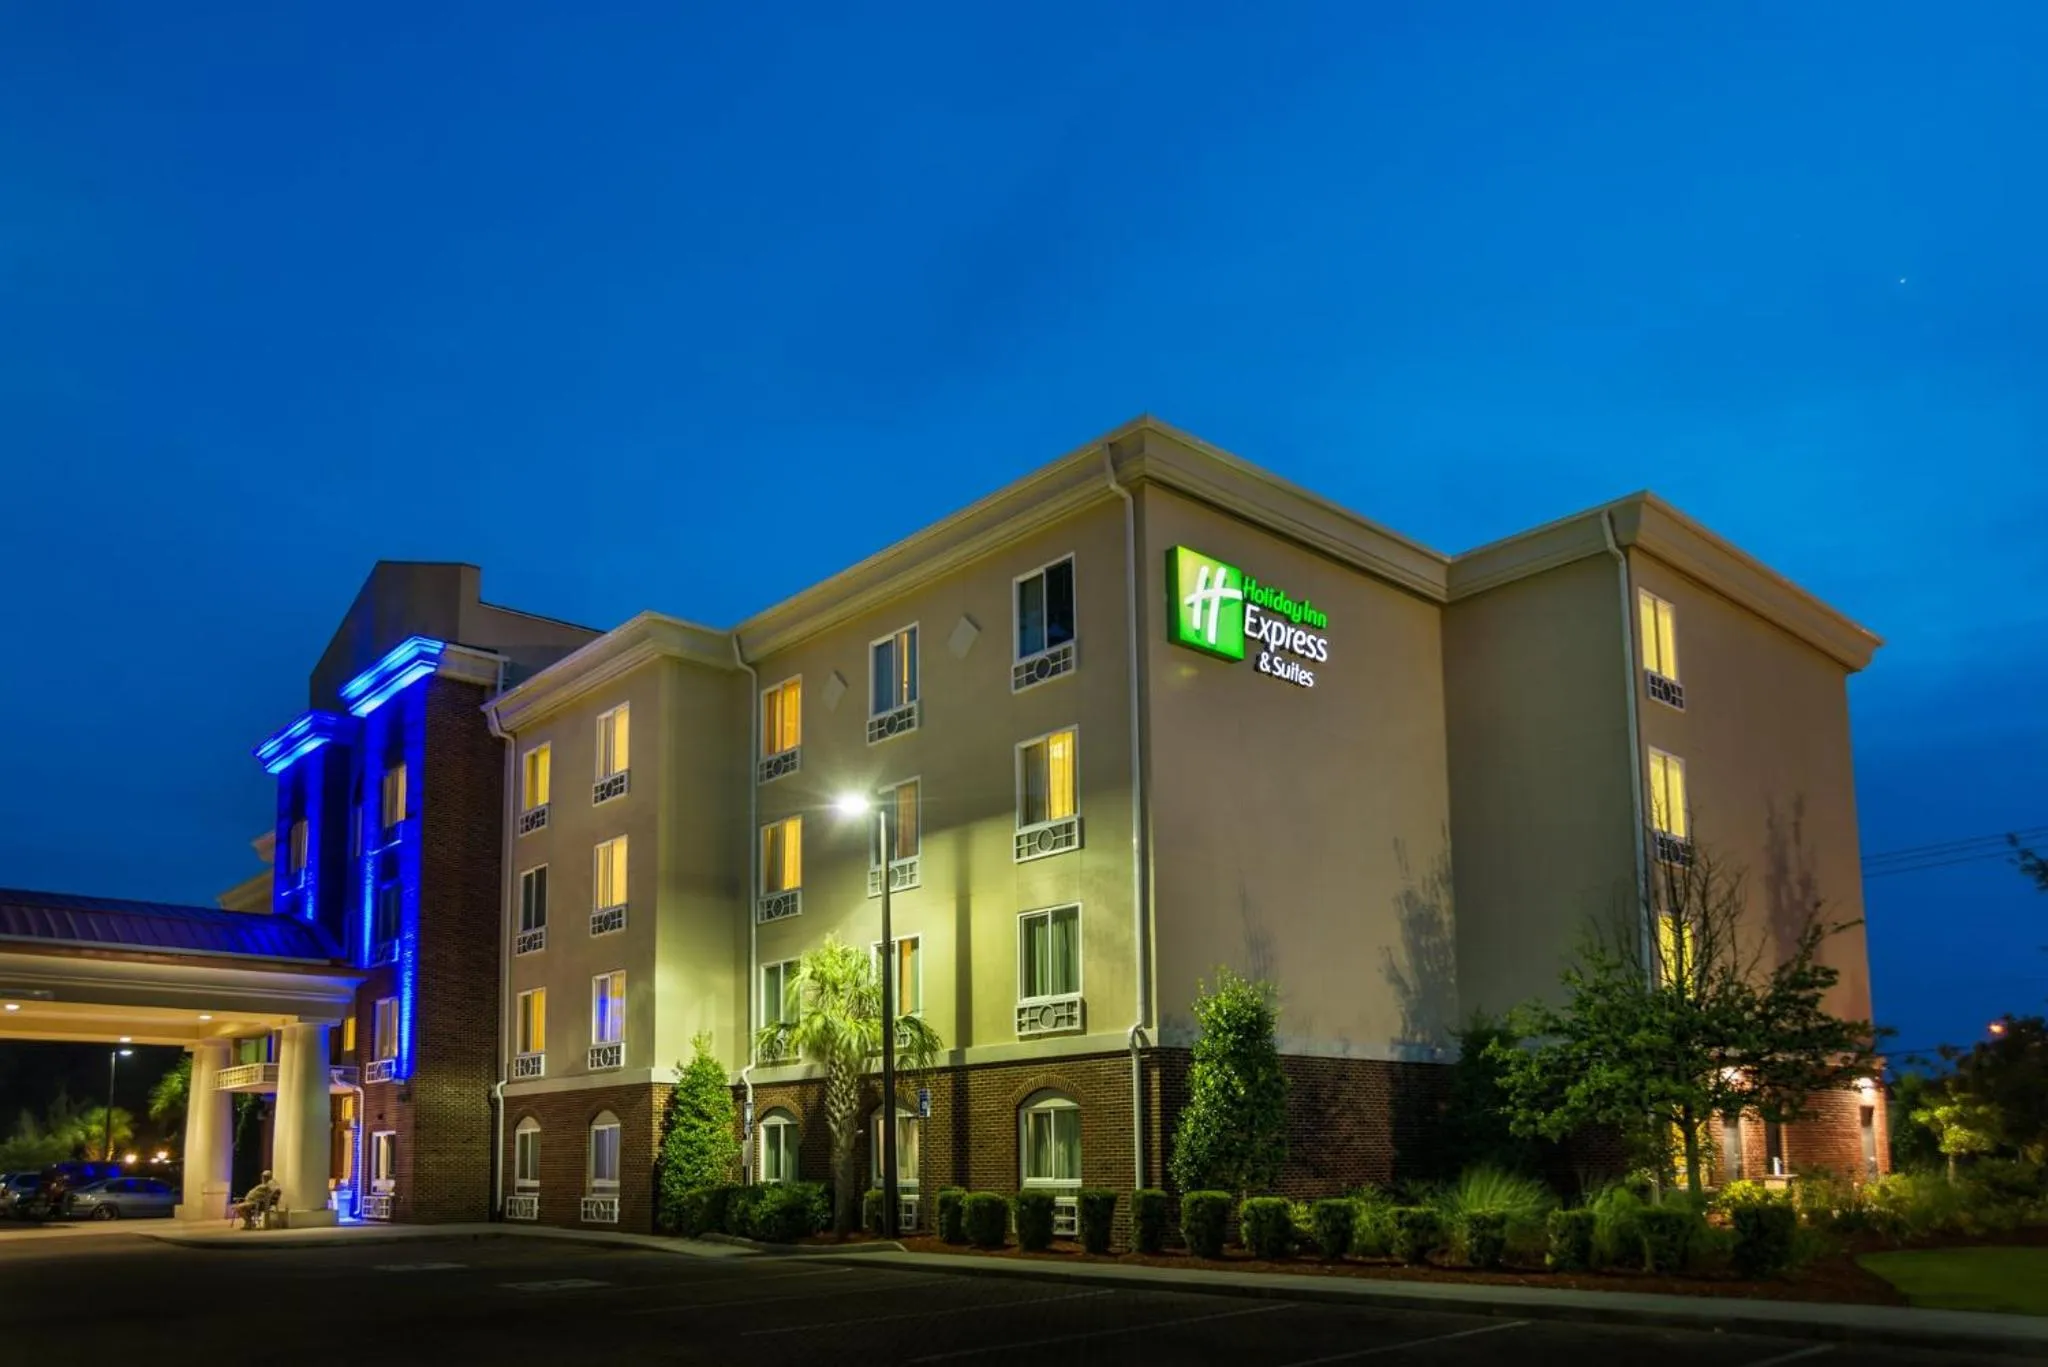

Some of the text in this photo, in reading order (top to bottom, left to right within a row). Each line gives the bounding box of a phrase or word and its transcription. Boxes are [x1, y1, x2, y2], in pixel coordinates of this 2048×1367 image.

[1184, 565, 1243, 645] H
[1243, 576, 1327, 629] Holiday Inn
[1244, 603, 1328, 662] Express
[1259, 651, 1314, 688] & Suites
